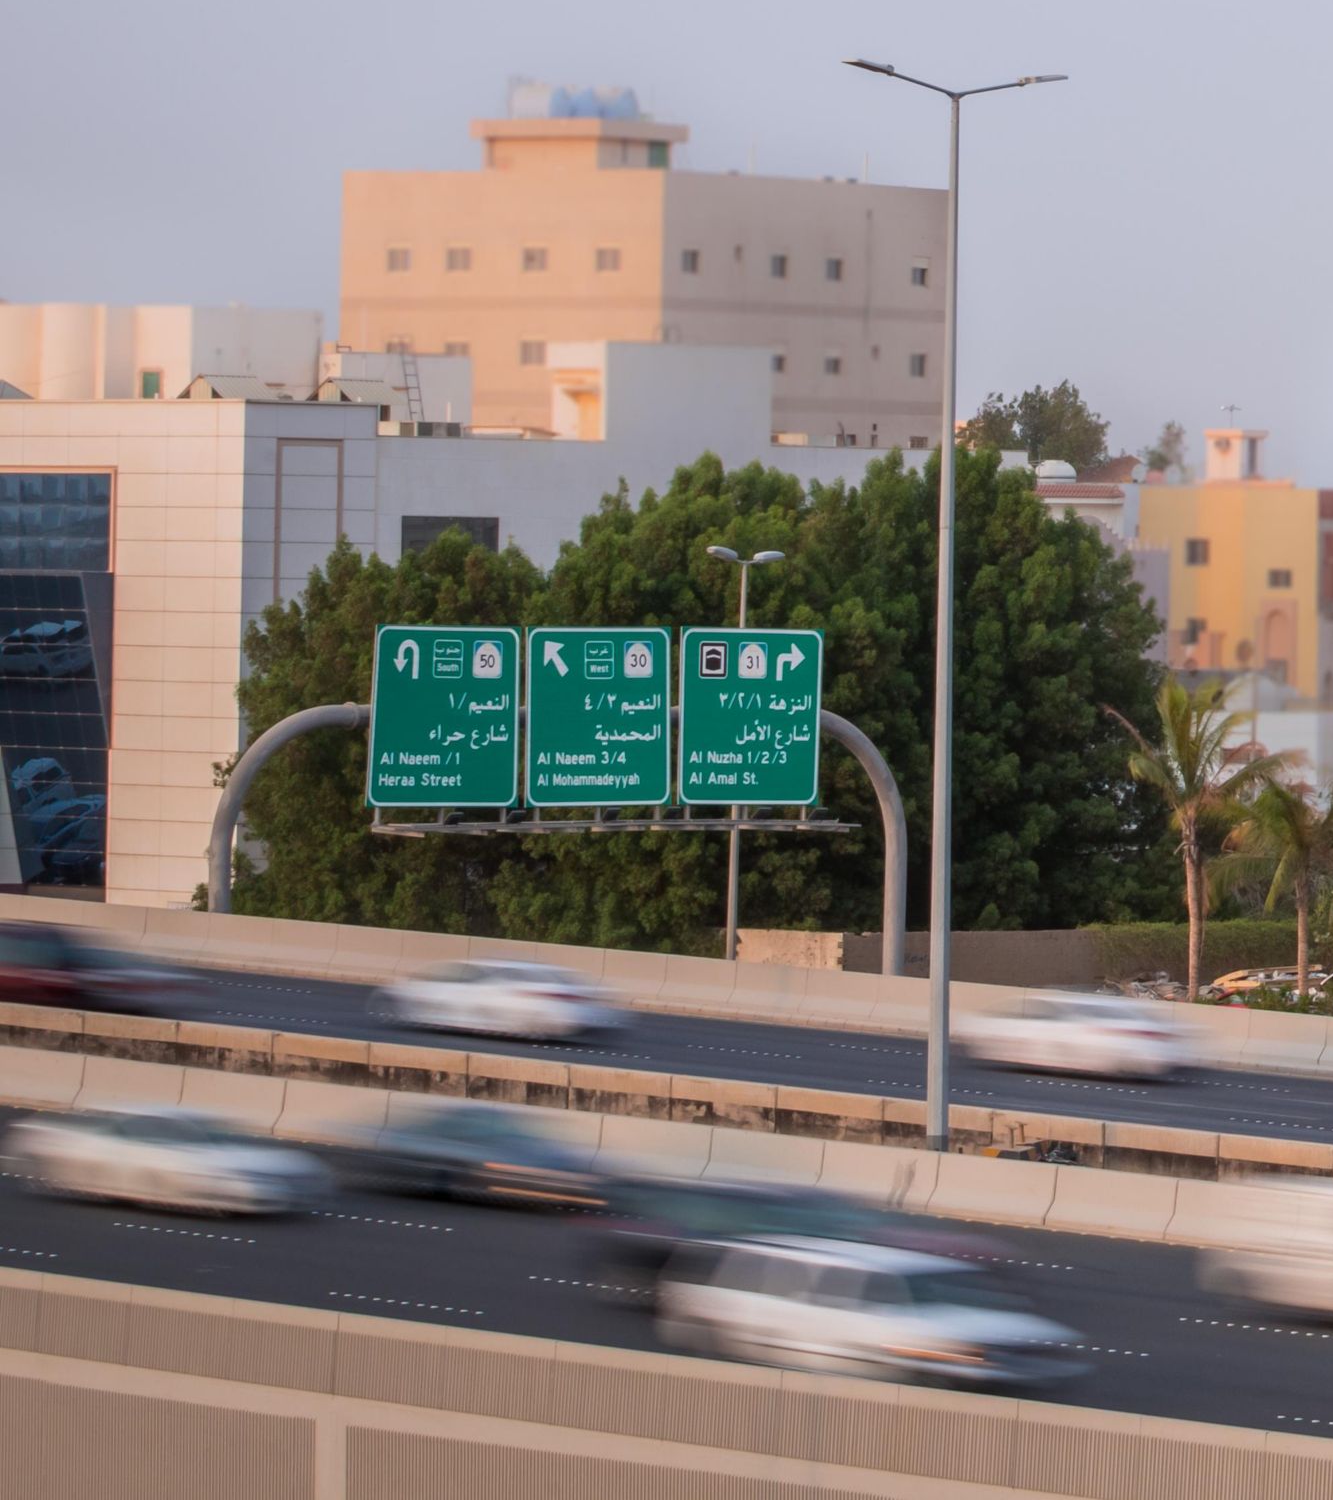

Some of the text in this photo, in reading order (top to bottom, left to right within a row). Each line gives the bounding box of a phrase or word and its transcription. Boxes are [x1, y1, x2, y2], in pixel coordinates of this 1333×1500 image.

[435, 647, 461, 655] جنوب
[589, 646, 609, 655] غرب
[437, 663, 459, 671] South
[480, 654, 495, 668] 50
[630, 654, 647, 667] 30
[746, 656, 760, 669] 31
[590, 664, 609, 673] West
[621, 693, 661, 715] النعيم
[769, 694, 811, 715] النزهة
[429, 724, 509, 749] شارع حراء
[595, 724, 661, 745] المحمدية
[736, 719, 811, 749] شارع الأمل
[380, 752, 394, 765] Al
[399, 752, 441, 765] Naeem
[537, 751, 626, 765] Al Naeem 3/4
[689, 751, 702, 764] Al
[707, 751, 743, 764] Nuzha
[378, 773, 462, 786] Heraa Street
[537, 773, 640, 788] Al Mohammadeyyah
[689, 772, 759, 785] Al Amal St.
